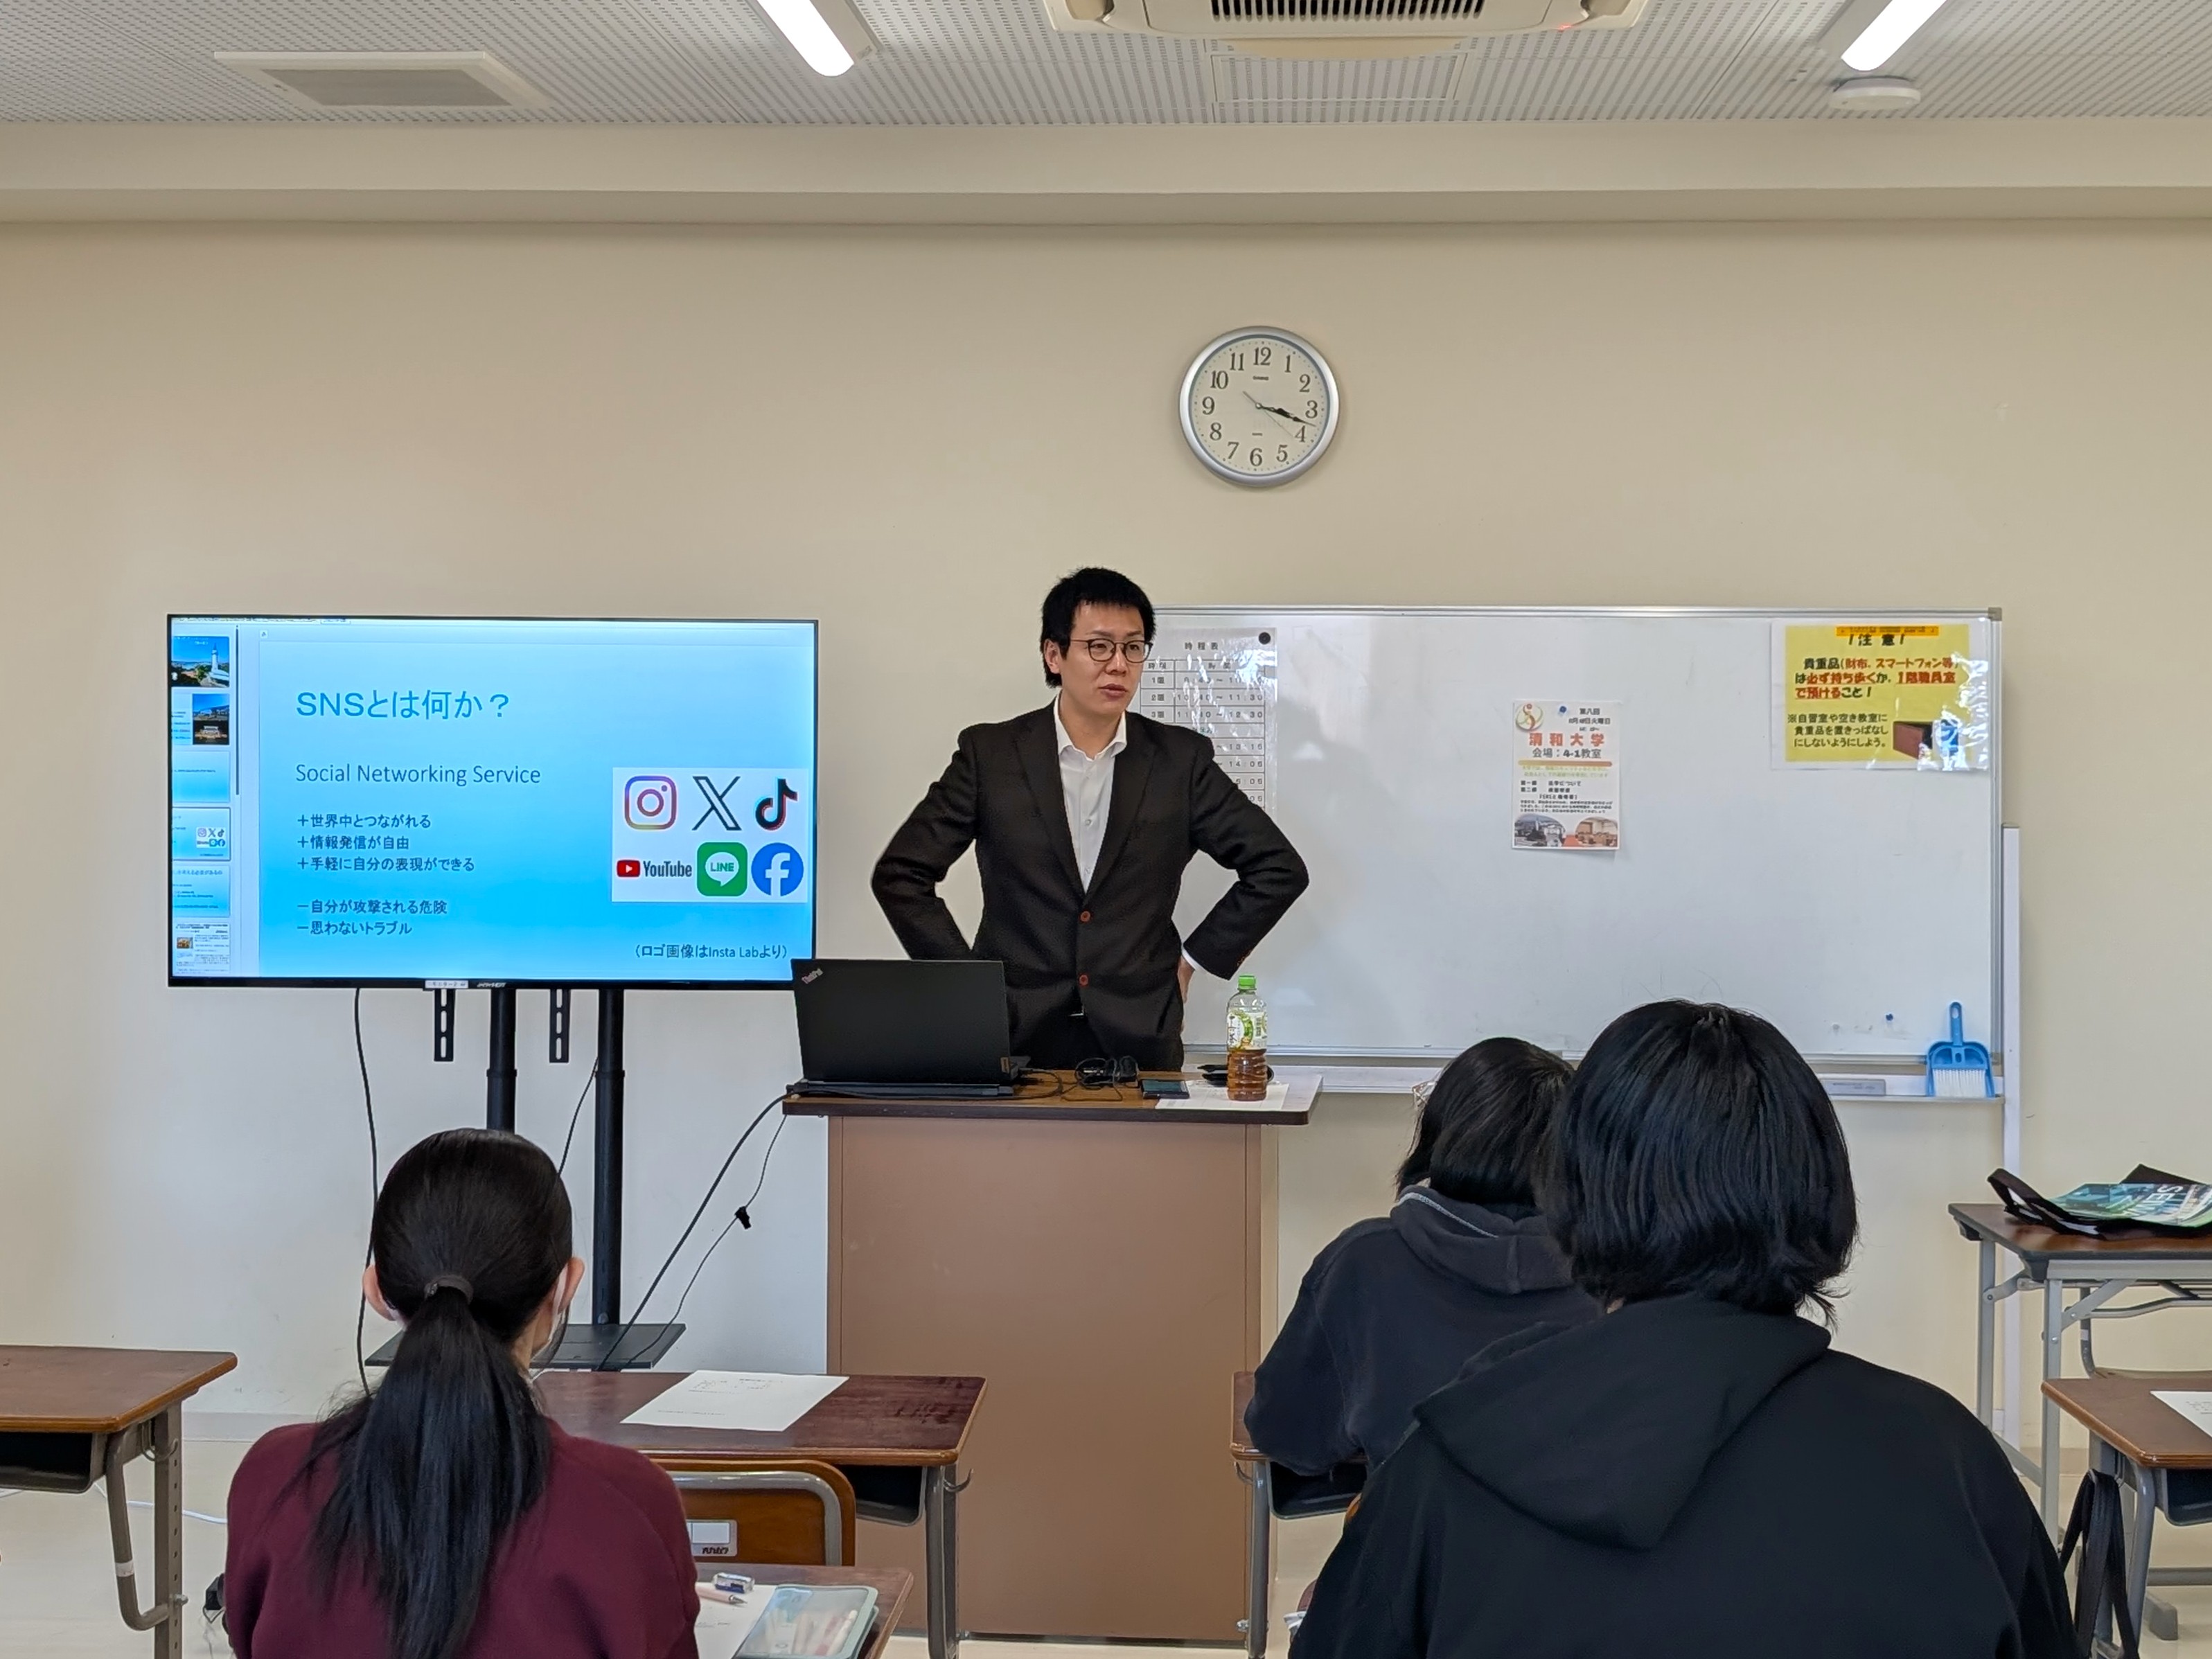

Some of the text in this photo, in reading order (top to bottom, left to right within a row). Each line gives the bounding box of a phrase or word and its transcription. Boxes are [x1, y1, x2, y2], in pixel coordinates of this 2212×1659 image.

[1230, 352, 1245, 371] 11
[1253, 346, 1272, 366] 12
[1284, 354, 1291, 373] 1
[1210, 370, 1229, 389] 10
[1299, 373, 1311, 393] 2
[1202, 396, 1215, 415] 9
[1305, 400, 1318, 418] 3
[1210, 422, 1222, 441] 8
[1295, 425, 1306, 443] 4
[1228, 441, 1239, 459] 7
[1249, 447, 1263, 467] 6
[1276, 444, 1288, 462] 5
[296, 689, 509, 720] SNSとは何か？
[1794, 726, 1889, 736] 貴重品を置きっぱなし
[1794, 737, 1886, 748] にしないようにしよう。
[296, 763, 540, 787] Social Networking Service
[297, 814, 432, 828] ＋世界中とつながれる
[297, 835, 409, 850] ＋情報発信が自由
[297, 856, 475, 871] ＋手軽に自分の表現ができる
[643, 861, 692, 878] YouTube
[710, 862, 734, 872] LINE
